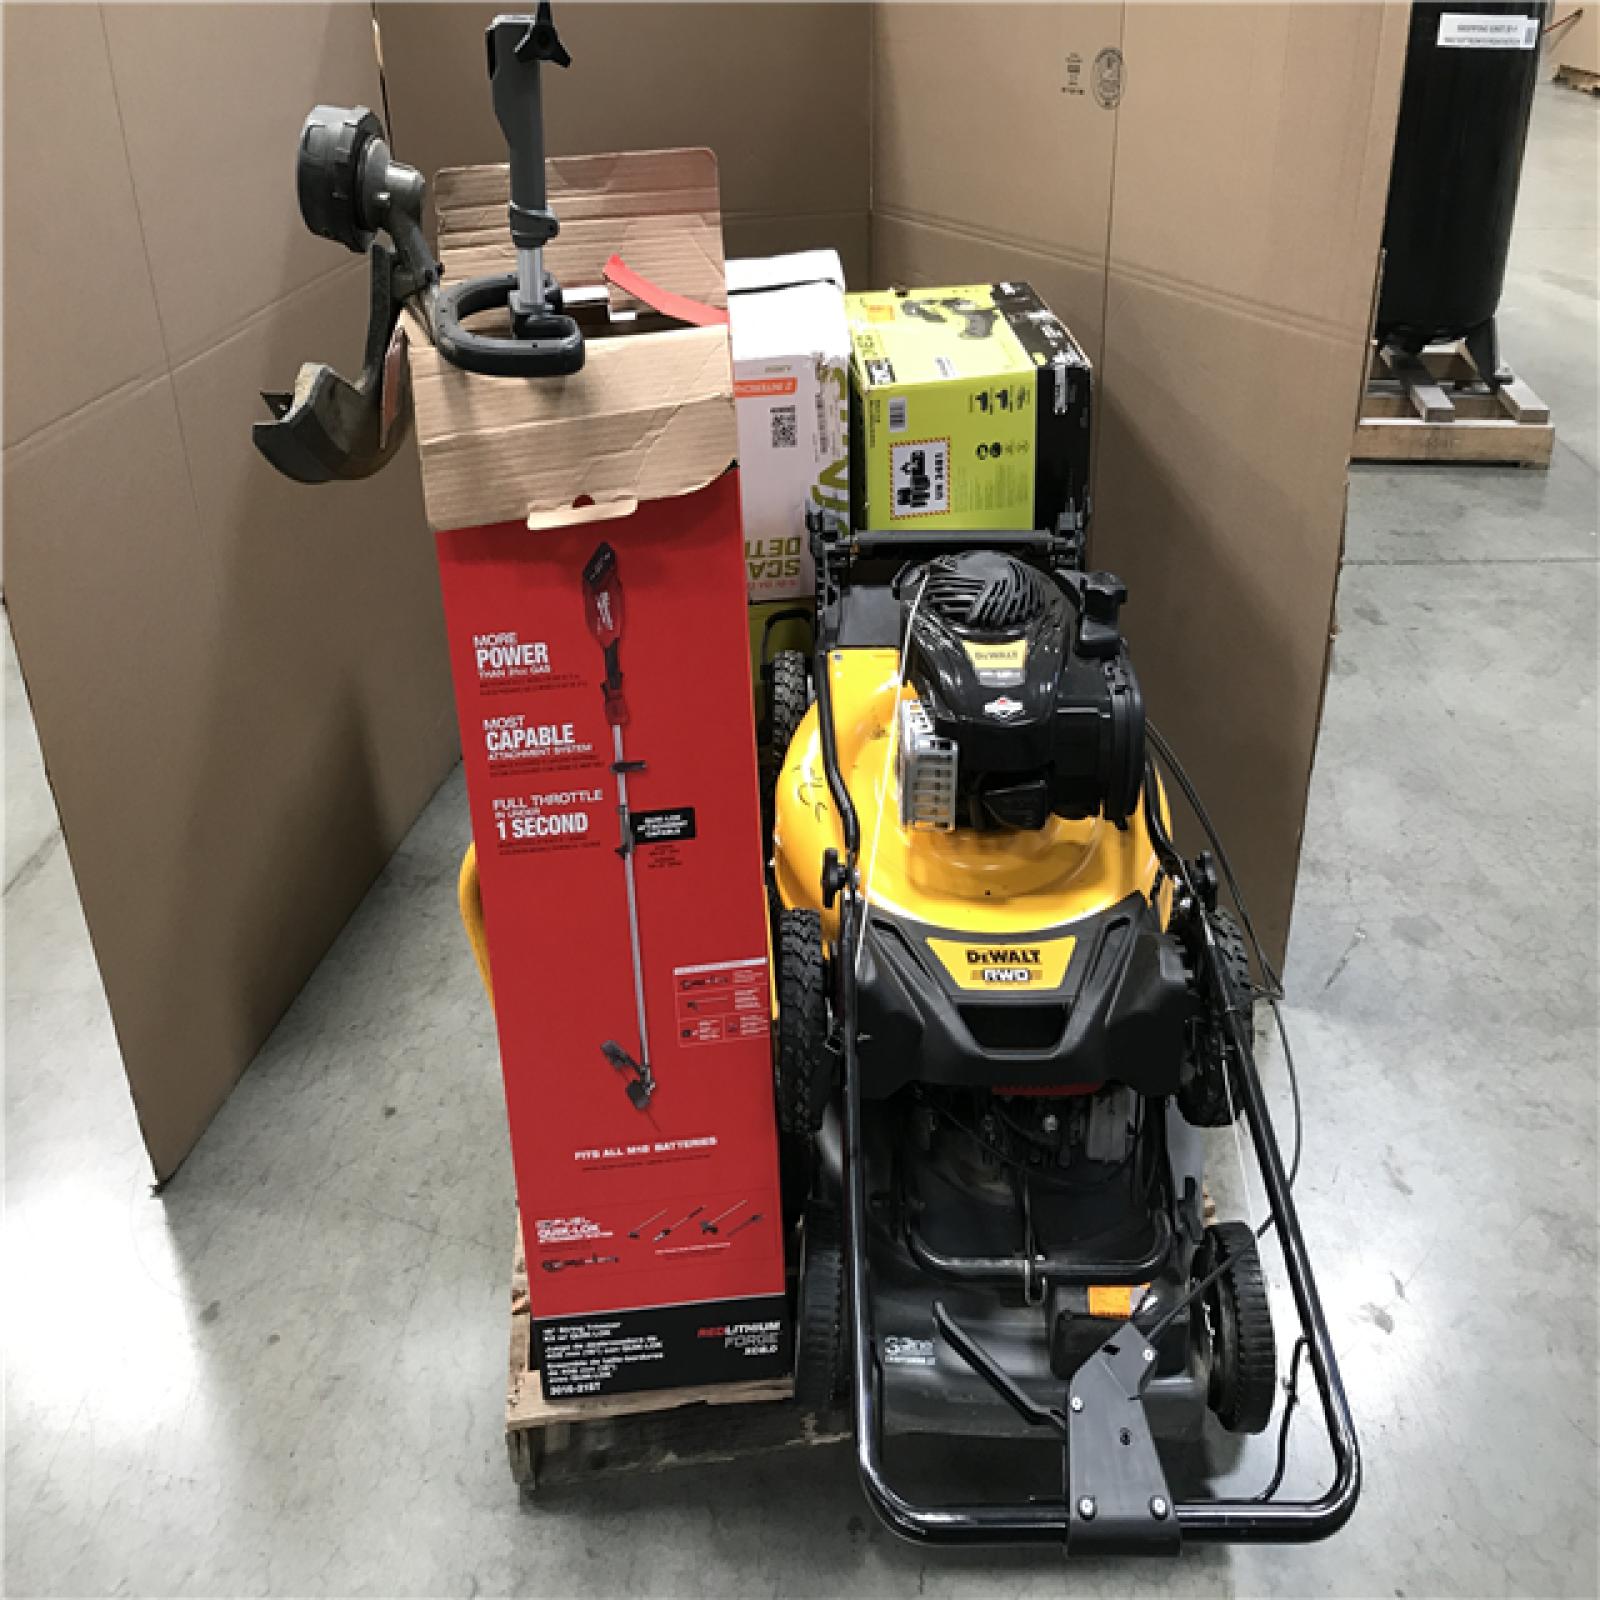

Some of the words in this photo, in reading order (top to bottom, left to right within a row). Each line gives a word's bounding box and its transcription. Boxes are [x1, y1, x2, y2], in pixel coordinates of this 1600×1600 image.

[472, 632, 518, 648] MORE
[476, 642, 549, 670] POWER
[482, 714, 525, 731] MOST
[486, 723, 576, 751] CAPABLE
[554, 743, 593, 756] SYSTEM
[492, 797, 528, 811] FULL
[530, 788, 604, 806] THROTTLE
[496, 819, 506, 841] 1
[512, 812, 589, 839] SECOND
[574, 1150, 600, 1161] FITS
[603, 1147, 623, 1157] ALL
[654, 1136, 718, 1152] BATTERIES
